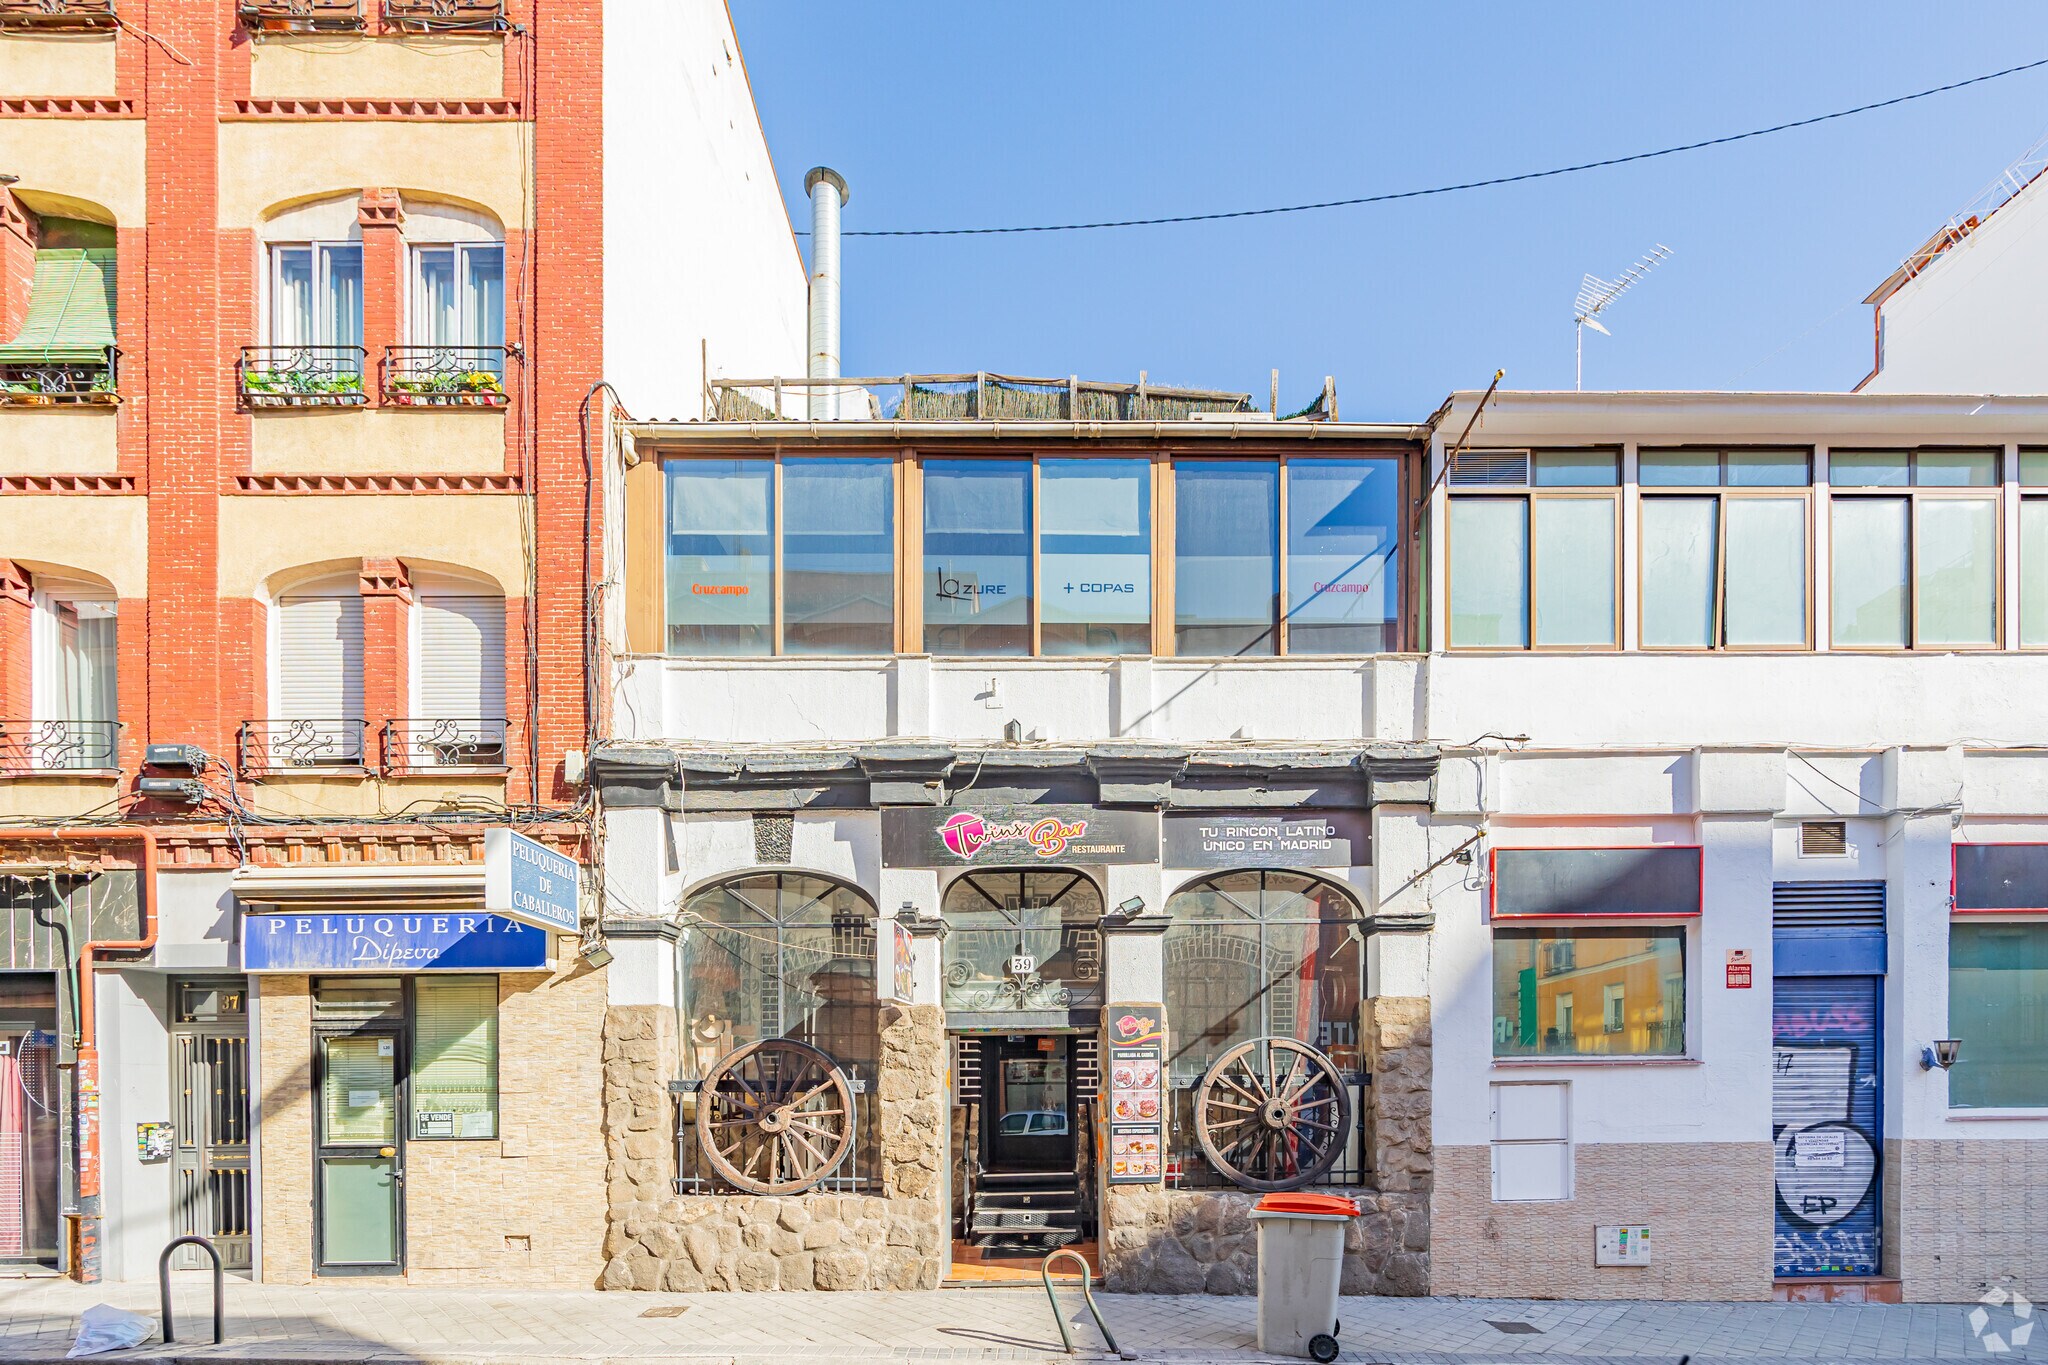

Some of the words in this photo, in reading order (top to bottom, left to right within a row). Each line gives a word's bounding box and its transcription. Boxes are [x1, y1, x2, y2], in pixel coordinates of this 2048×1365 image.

[692, 583, 749, 597] Cruzcampo
[1080, 583, 1134, 593] COPAS
[1313, 582, 1369, 594] Cruzcampo
[1200, 827, 1218, 837] TU
[1226, 824, 1278, 837] RINCÓN
[1286, 826, 1336, 837] LATINO
[937, 819, 1030, 858] Twins
[1029, 819, 1085, 856] Bar
[1203, 839, 1245, 851] ÚNICO
[1253, 841, 1273, 850] EN
[1281, 840, 1332, 850] MADRID
[1072, 844, 1125, 854] RESTAURANTE
[512, 840, 575, 881] PELUQUERIA
[539, 876, 553, 894] DE
[514, 890, 575, 924] CABALLEROS
[269, 917, 523, 935] PELUQUERIA
[1015, 958, 1031, 970] 39
[222, 995, 239, 1010] 37
